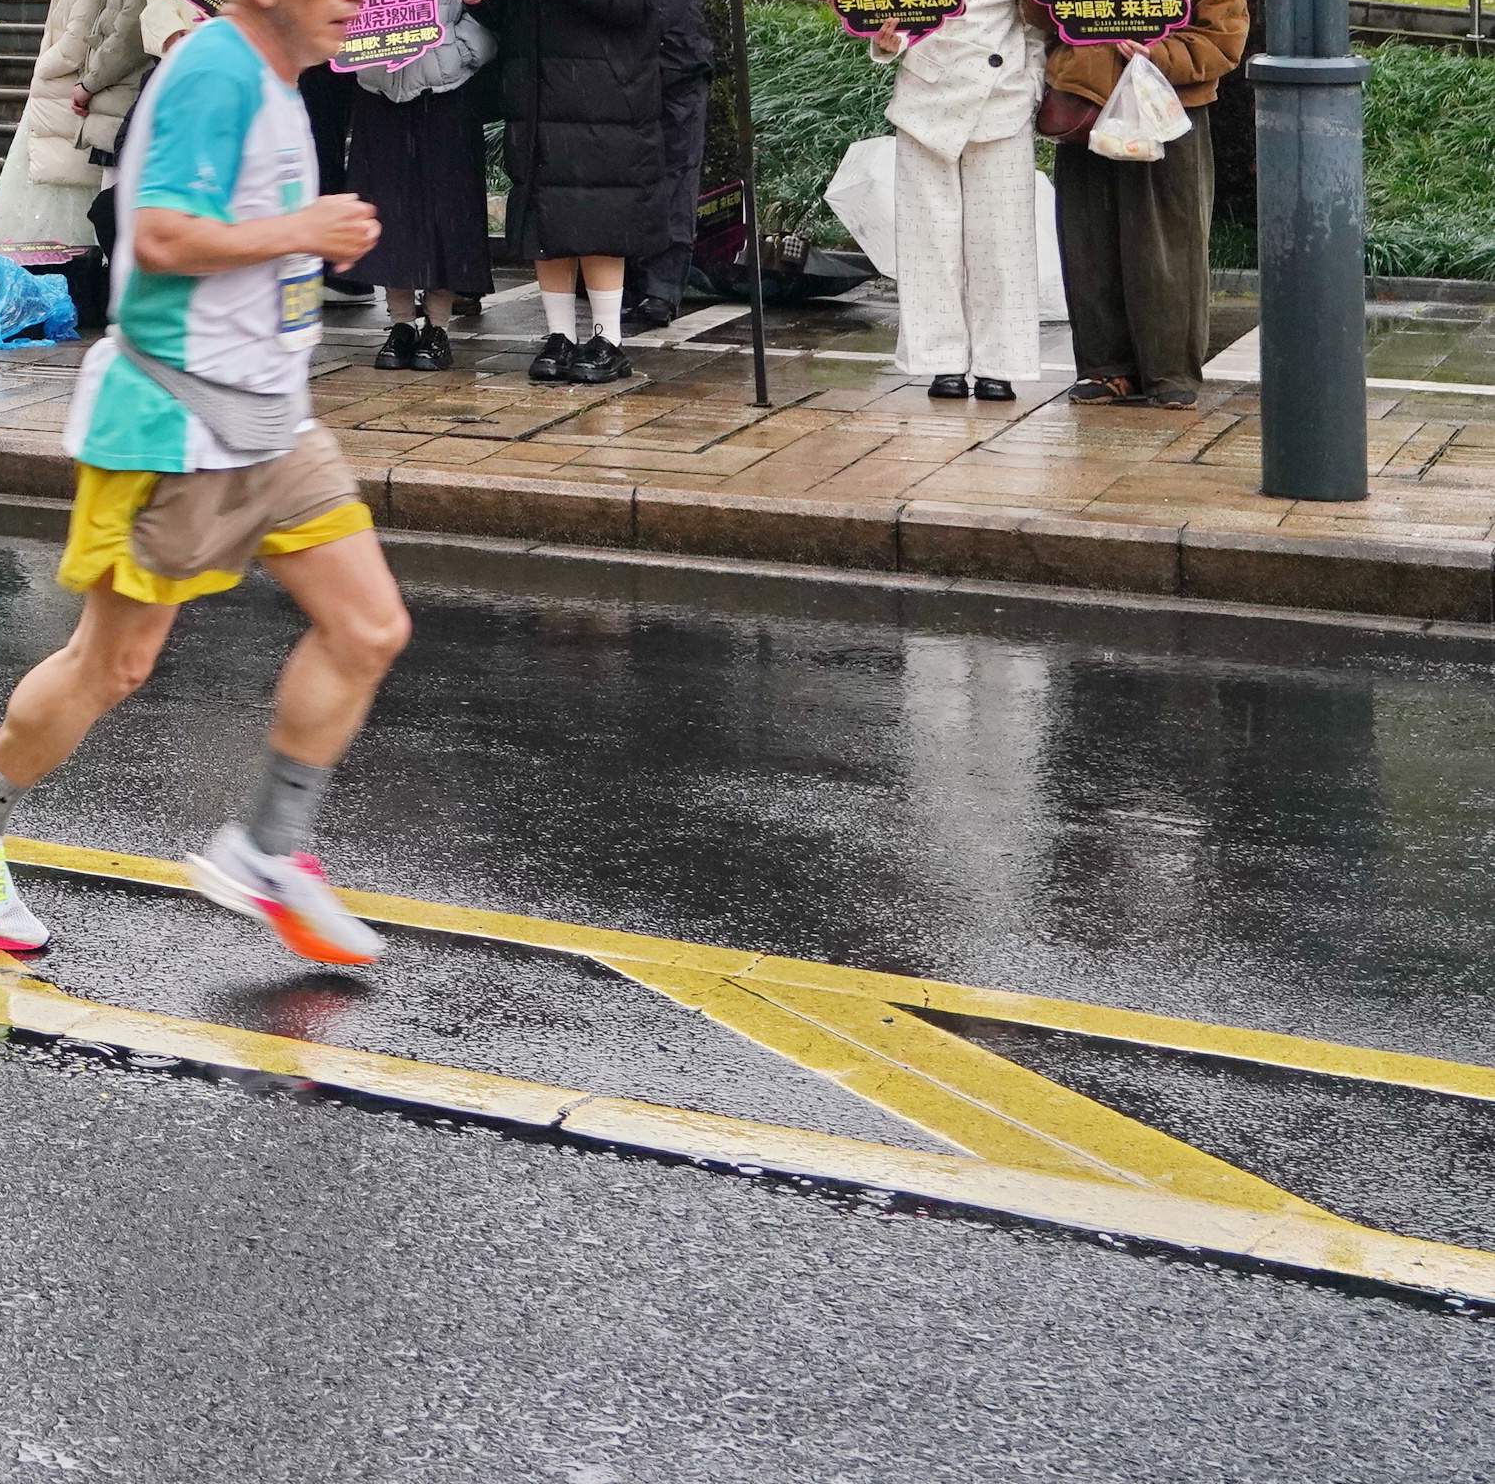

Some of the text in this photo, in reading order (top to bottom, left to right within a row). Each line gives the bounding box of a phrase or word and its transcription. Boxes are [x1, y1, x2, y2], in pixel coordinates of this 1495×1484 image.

[1055, 0, 1183, 19] 学唱歌 来耘歌
[385, 27, 439, 47] 来耘歌
